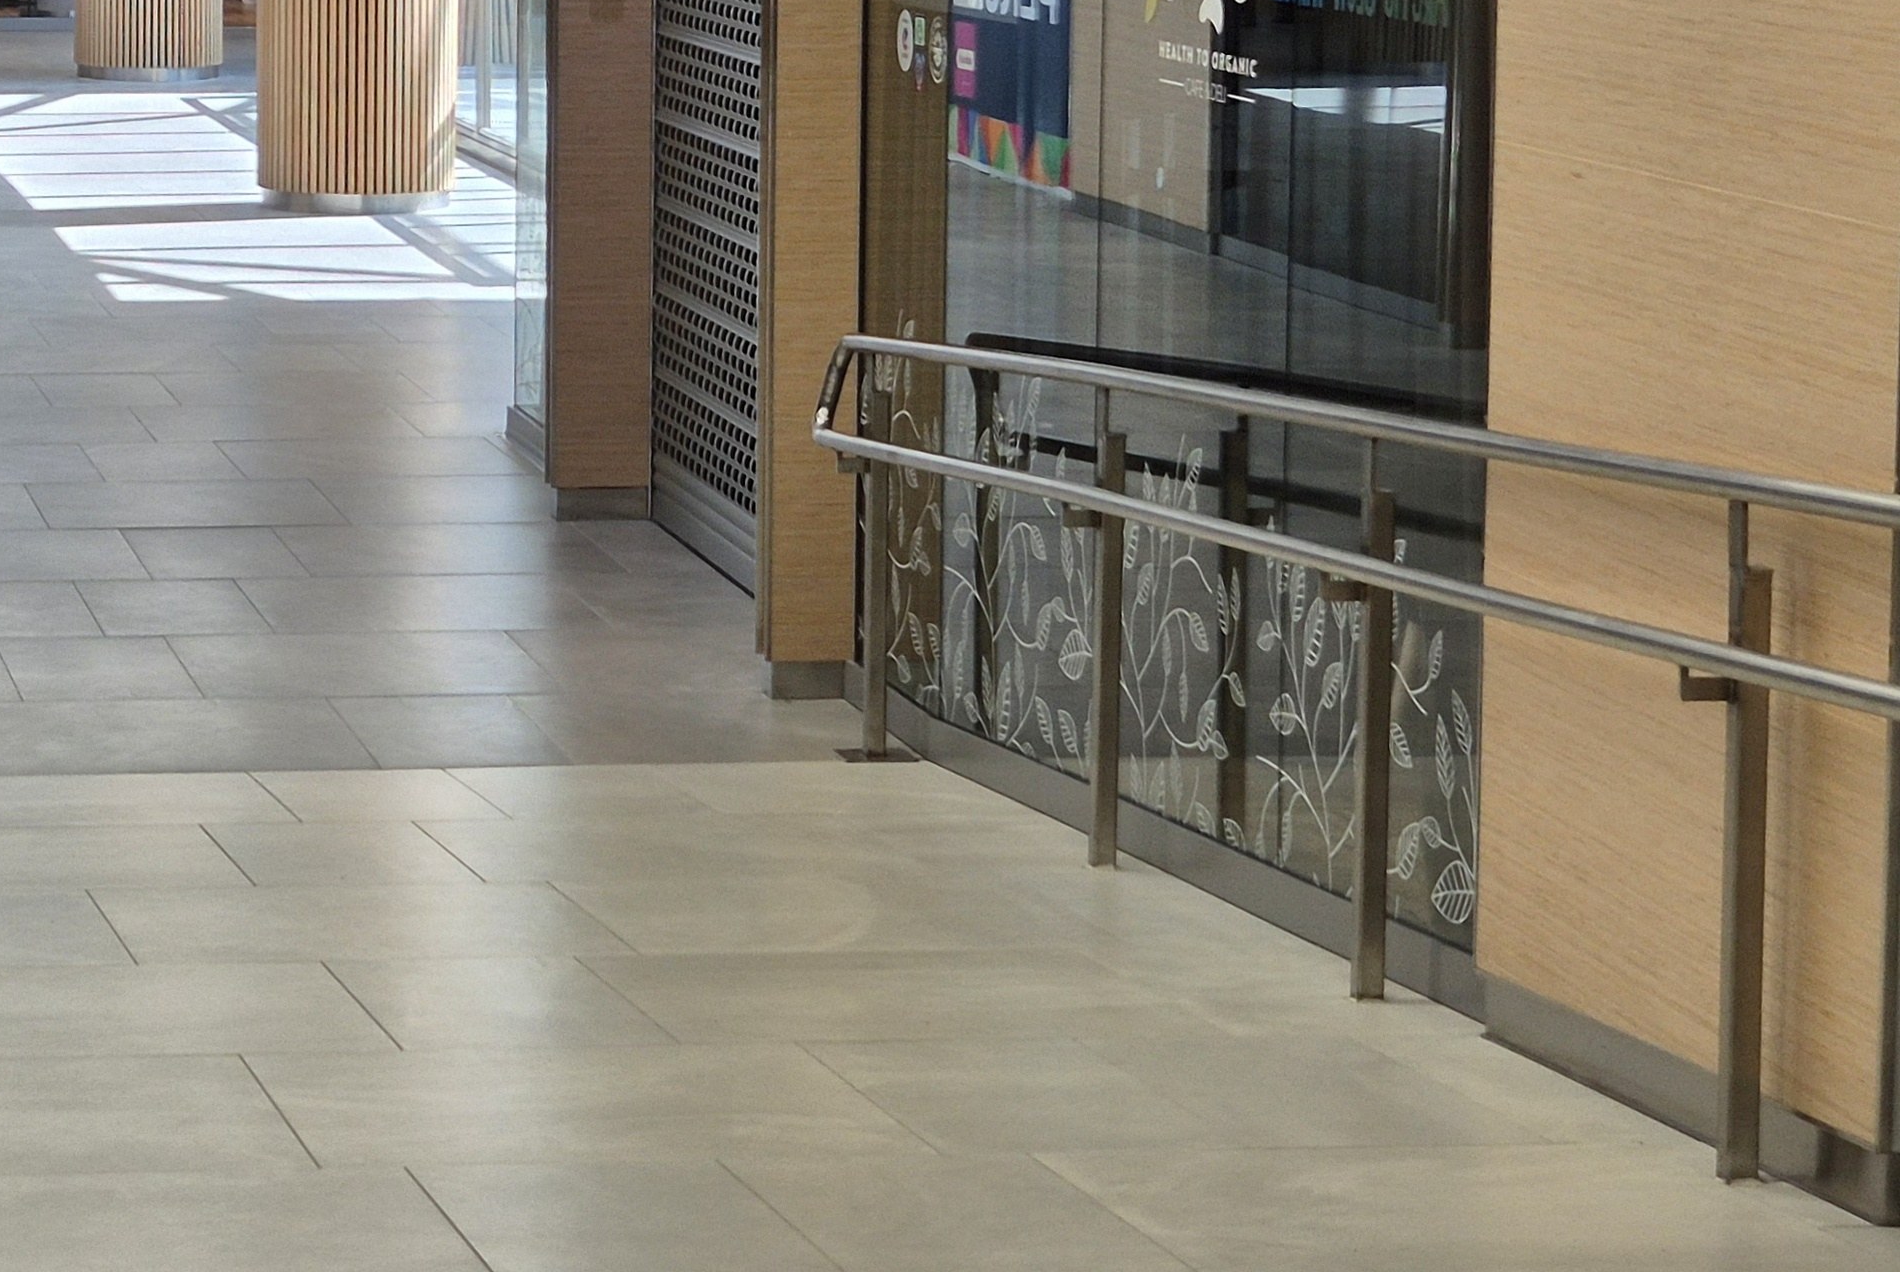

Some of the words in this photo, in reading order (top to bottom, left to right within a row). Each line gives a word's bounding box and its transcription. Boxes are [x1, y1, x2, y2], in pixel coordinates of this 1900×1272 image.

[1158, 39, 1194, 64] HEALTH
[1196, 47, 1209, 67] TO
[1211, 50, 1258, 78] ORGANIC
